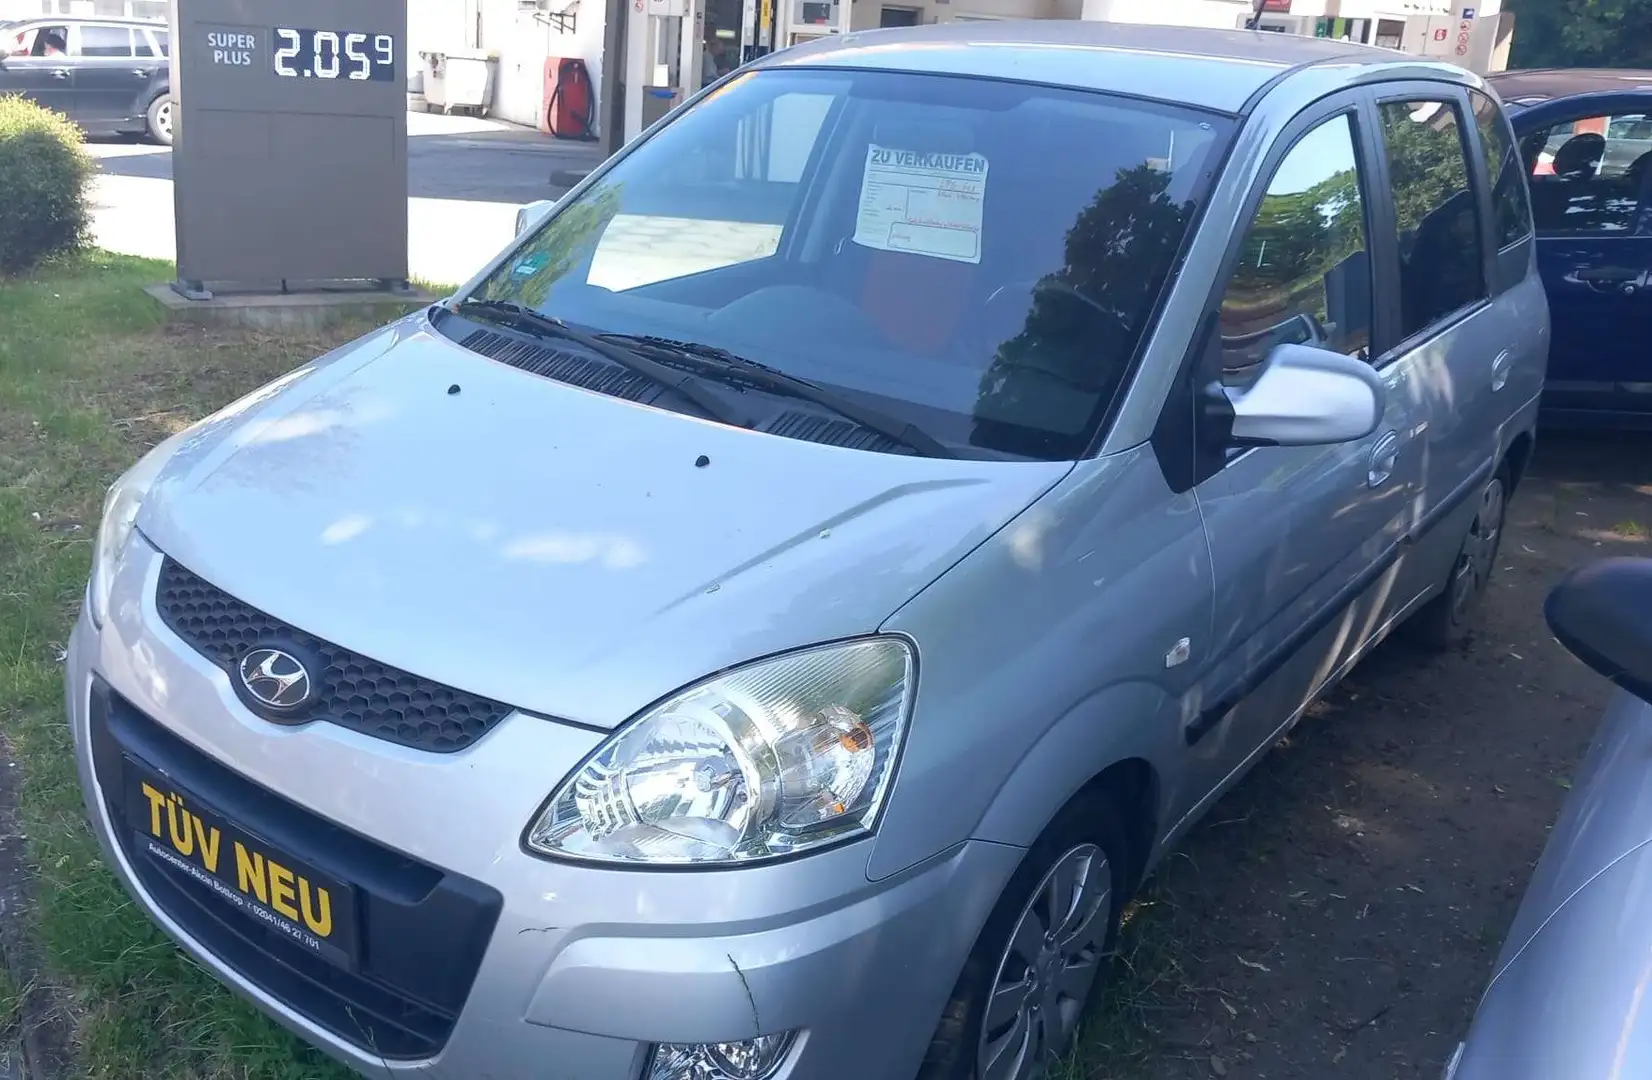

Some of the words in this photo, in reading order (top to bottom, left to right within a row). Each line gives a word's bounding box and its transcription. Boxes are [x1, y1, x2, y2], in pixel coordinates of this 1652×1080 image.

[207, 31, 256, 50] SUPER
[213, 50, 252, 66] PLUS
[870, 149, 890, 164] ZU
[896, 151, 985, 172] VERKAUFEN
[142, 781, 221, 873] TÜV
[234, 840, 332, 937] NEU
